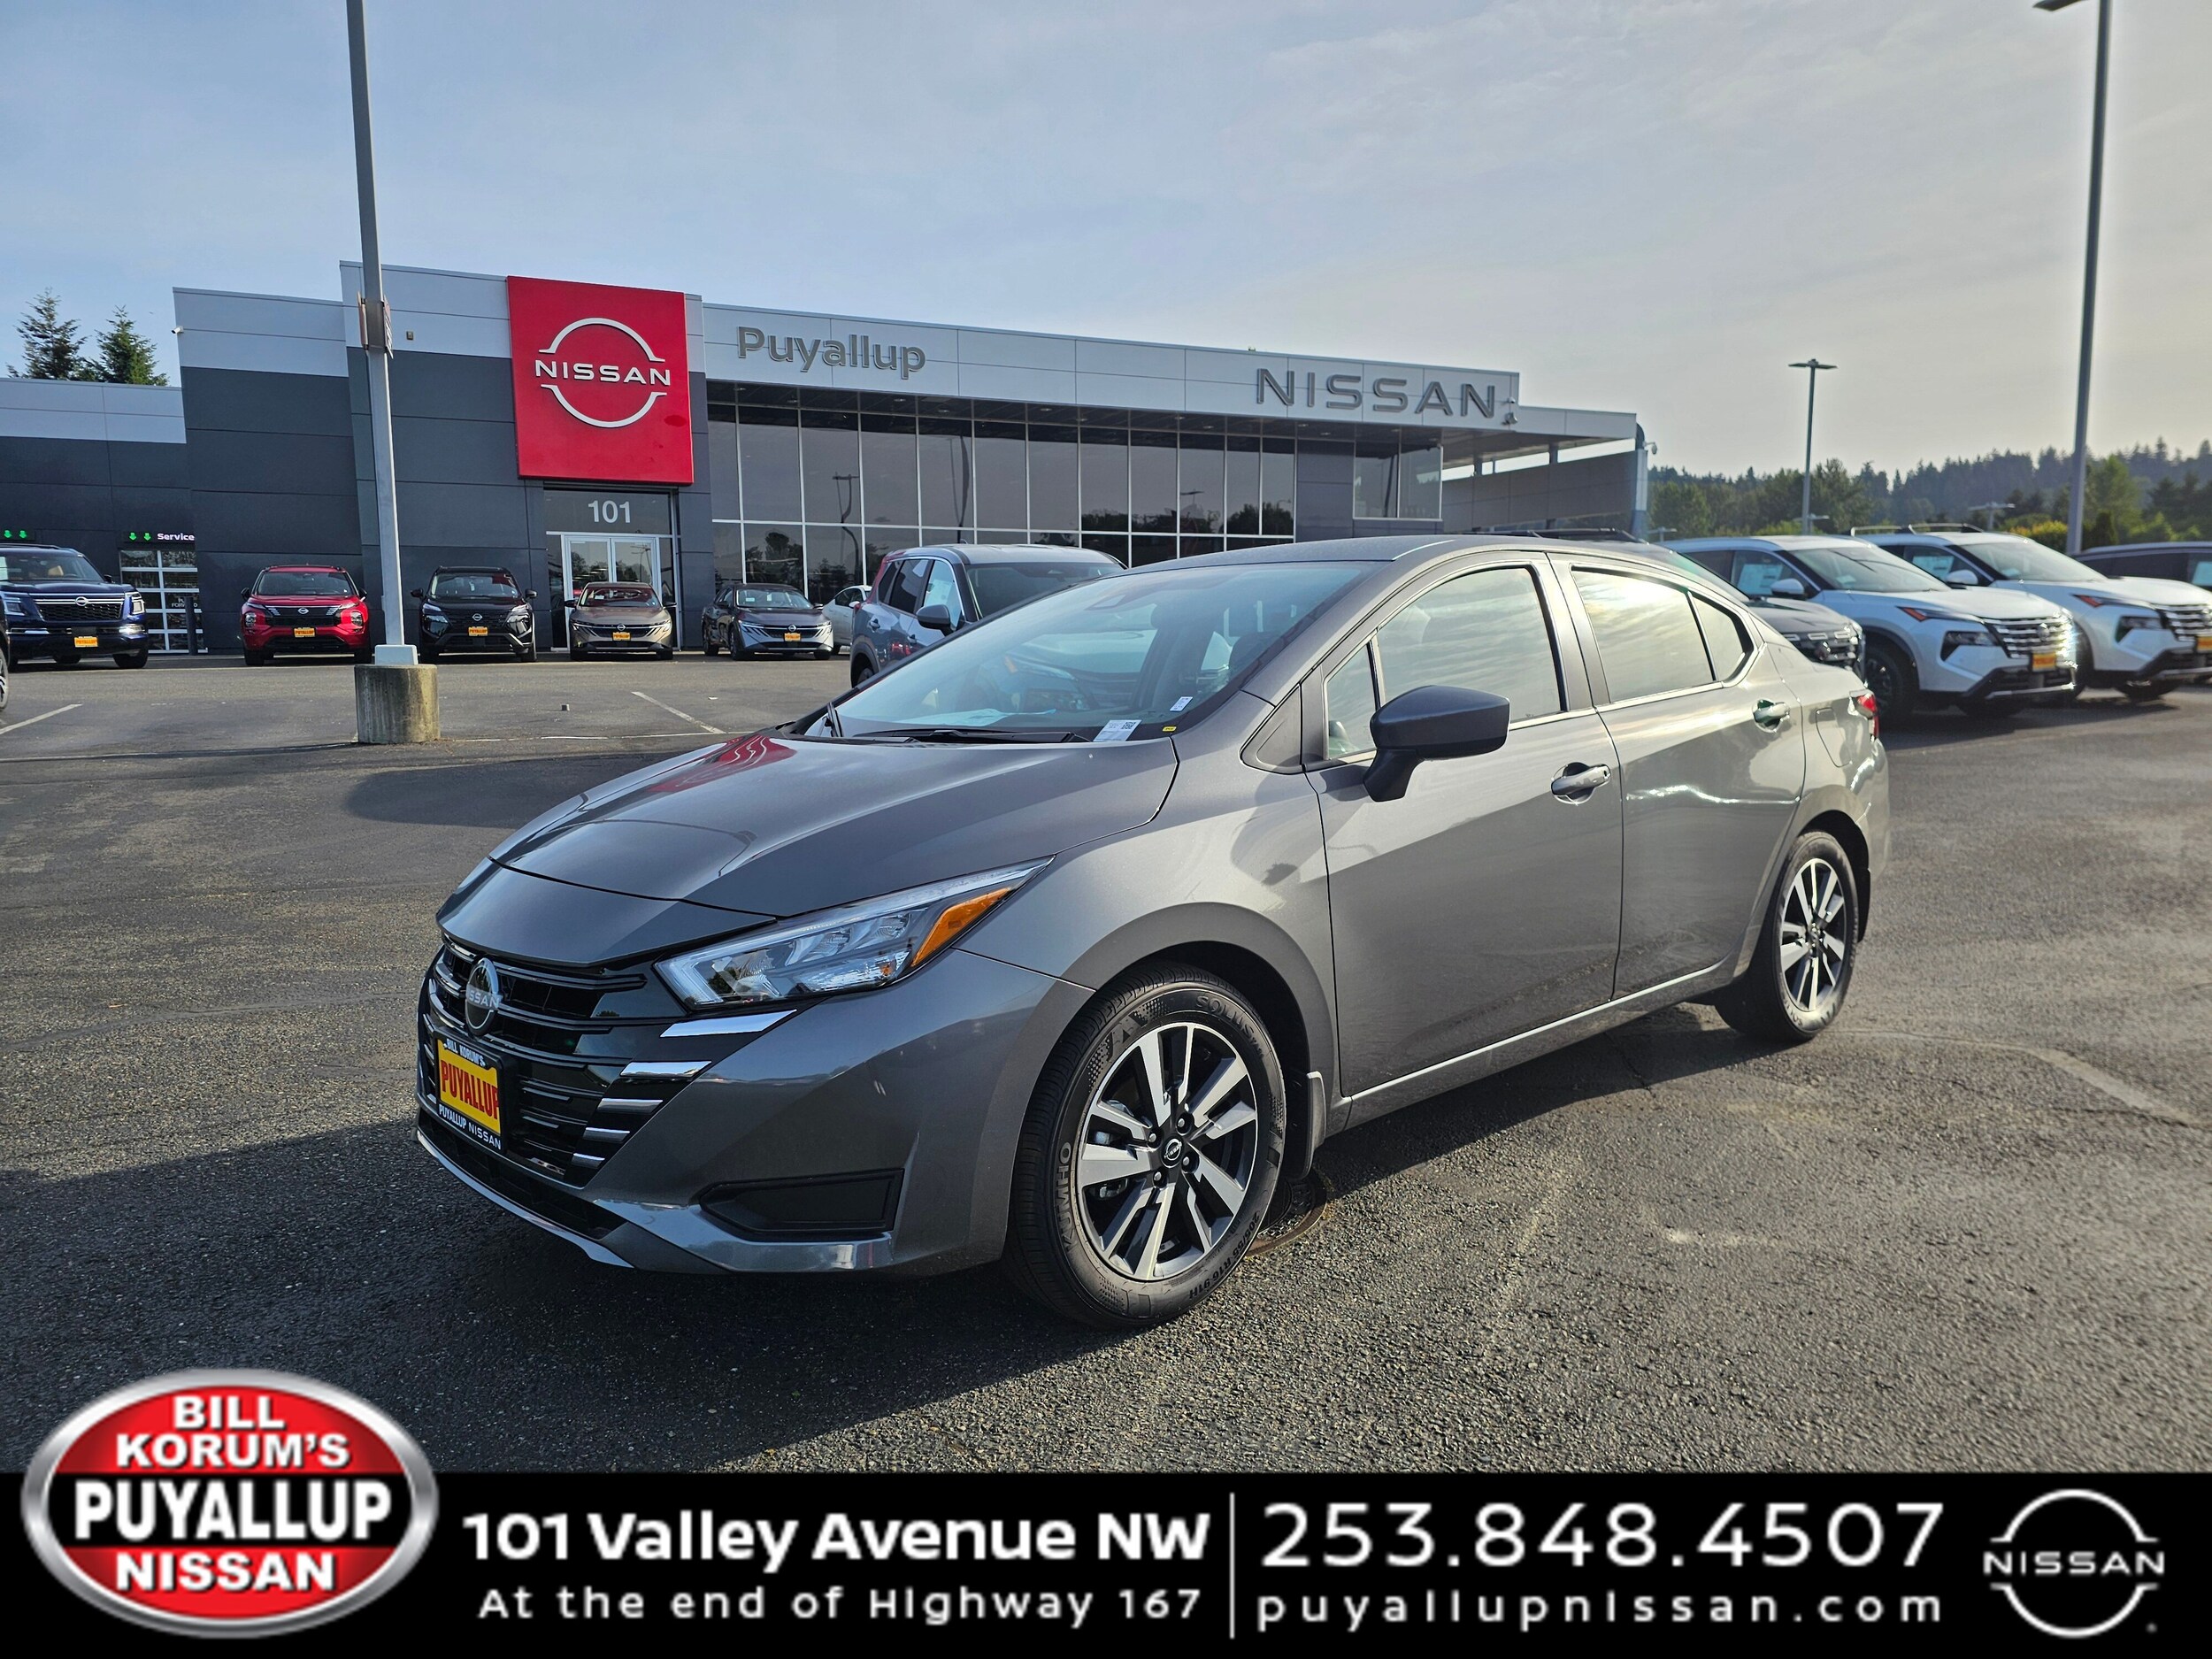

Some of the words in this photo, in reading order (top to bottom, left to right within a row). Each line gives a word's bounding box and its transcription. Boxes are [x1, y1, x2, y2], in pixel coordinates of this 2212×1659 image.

[534, 359, 671, 387] NISSAN
[738, 326, 926, 380] Puyallup
[1256, 367, 1495, 419] NISSAN
[588, 500, 631, 524] 101
[445, 1038, 458, 1054] BILL
[459, 1044, 486, 1067] KORUM'S
[441, 1059, 499, 1120] PUYALLUP
[439, 1103, 467, 1129] PUYALLUP
[468, 1122, 502, 1150] NISSAN
[1056, 1141, 1079, 1255] KUMHO
[1233, 1210, 1261, 1256] 205/55
[1188, 1278, 1211, 1299] 91H
[1211, 1257, 1233, 1280] R16
